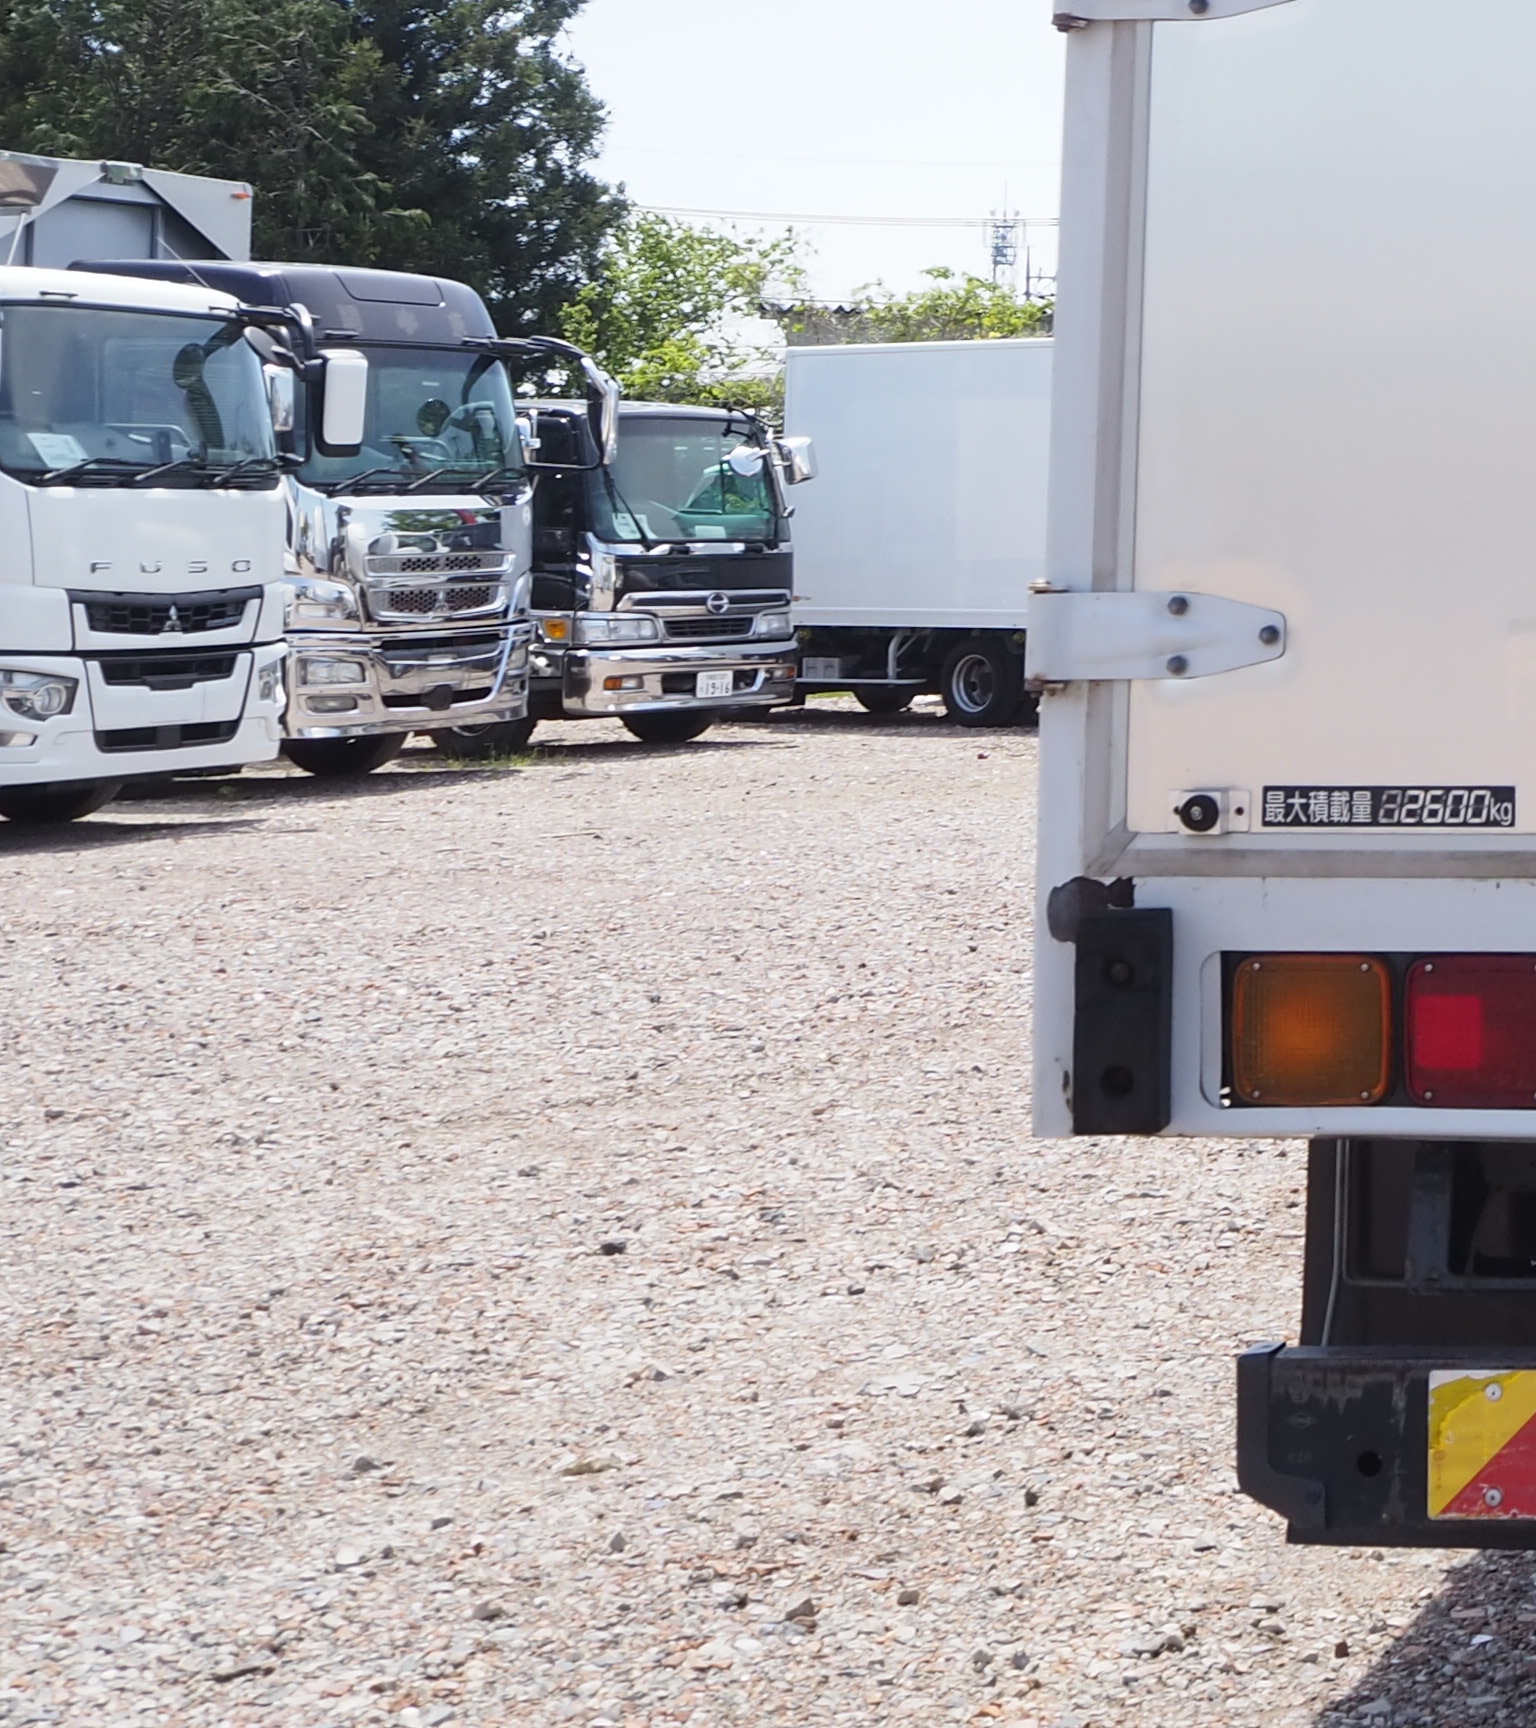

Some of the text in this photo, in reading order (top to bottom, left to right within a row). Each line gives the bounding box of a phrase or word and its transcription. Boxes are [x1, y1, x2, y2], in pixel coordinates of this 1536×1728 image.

[90, 558, 252, 574] FUSO
[1264, 790, 1373, 823] 最大積載量
